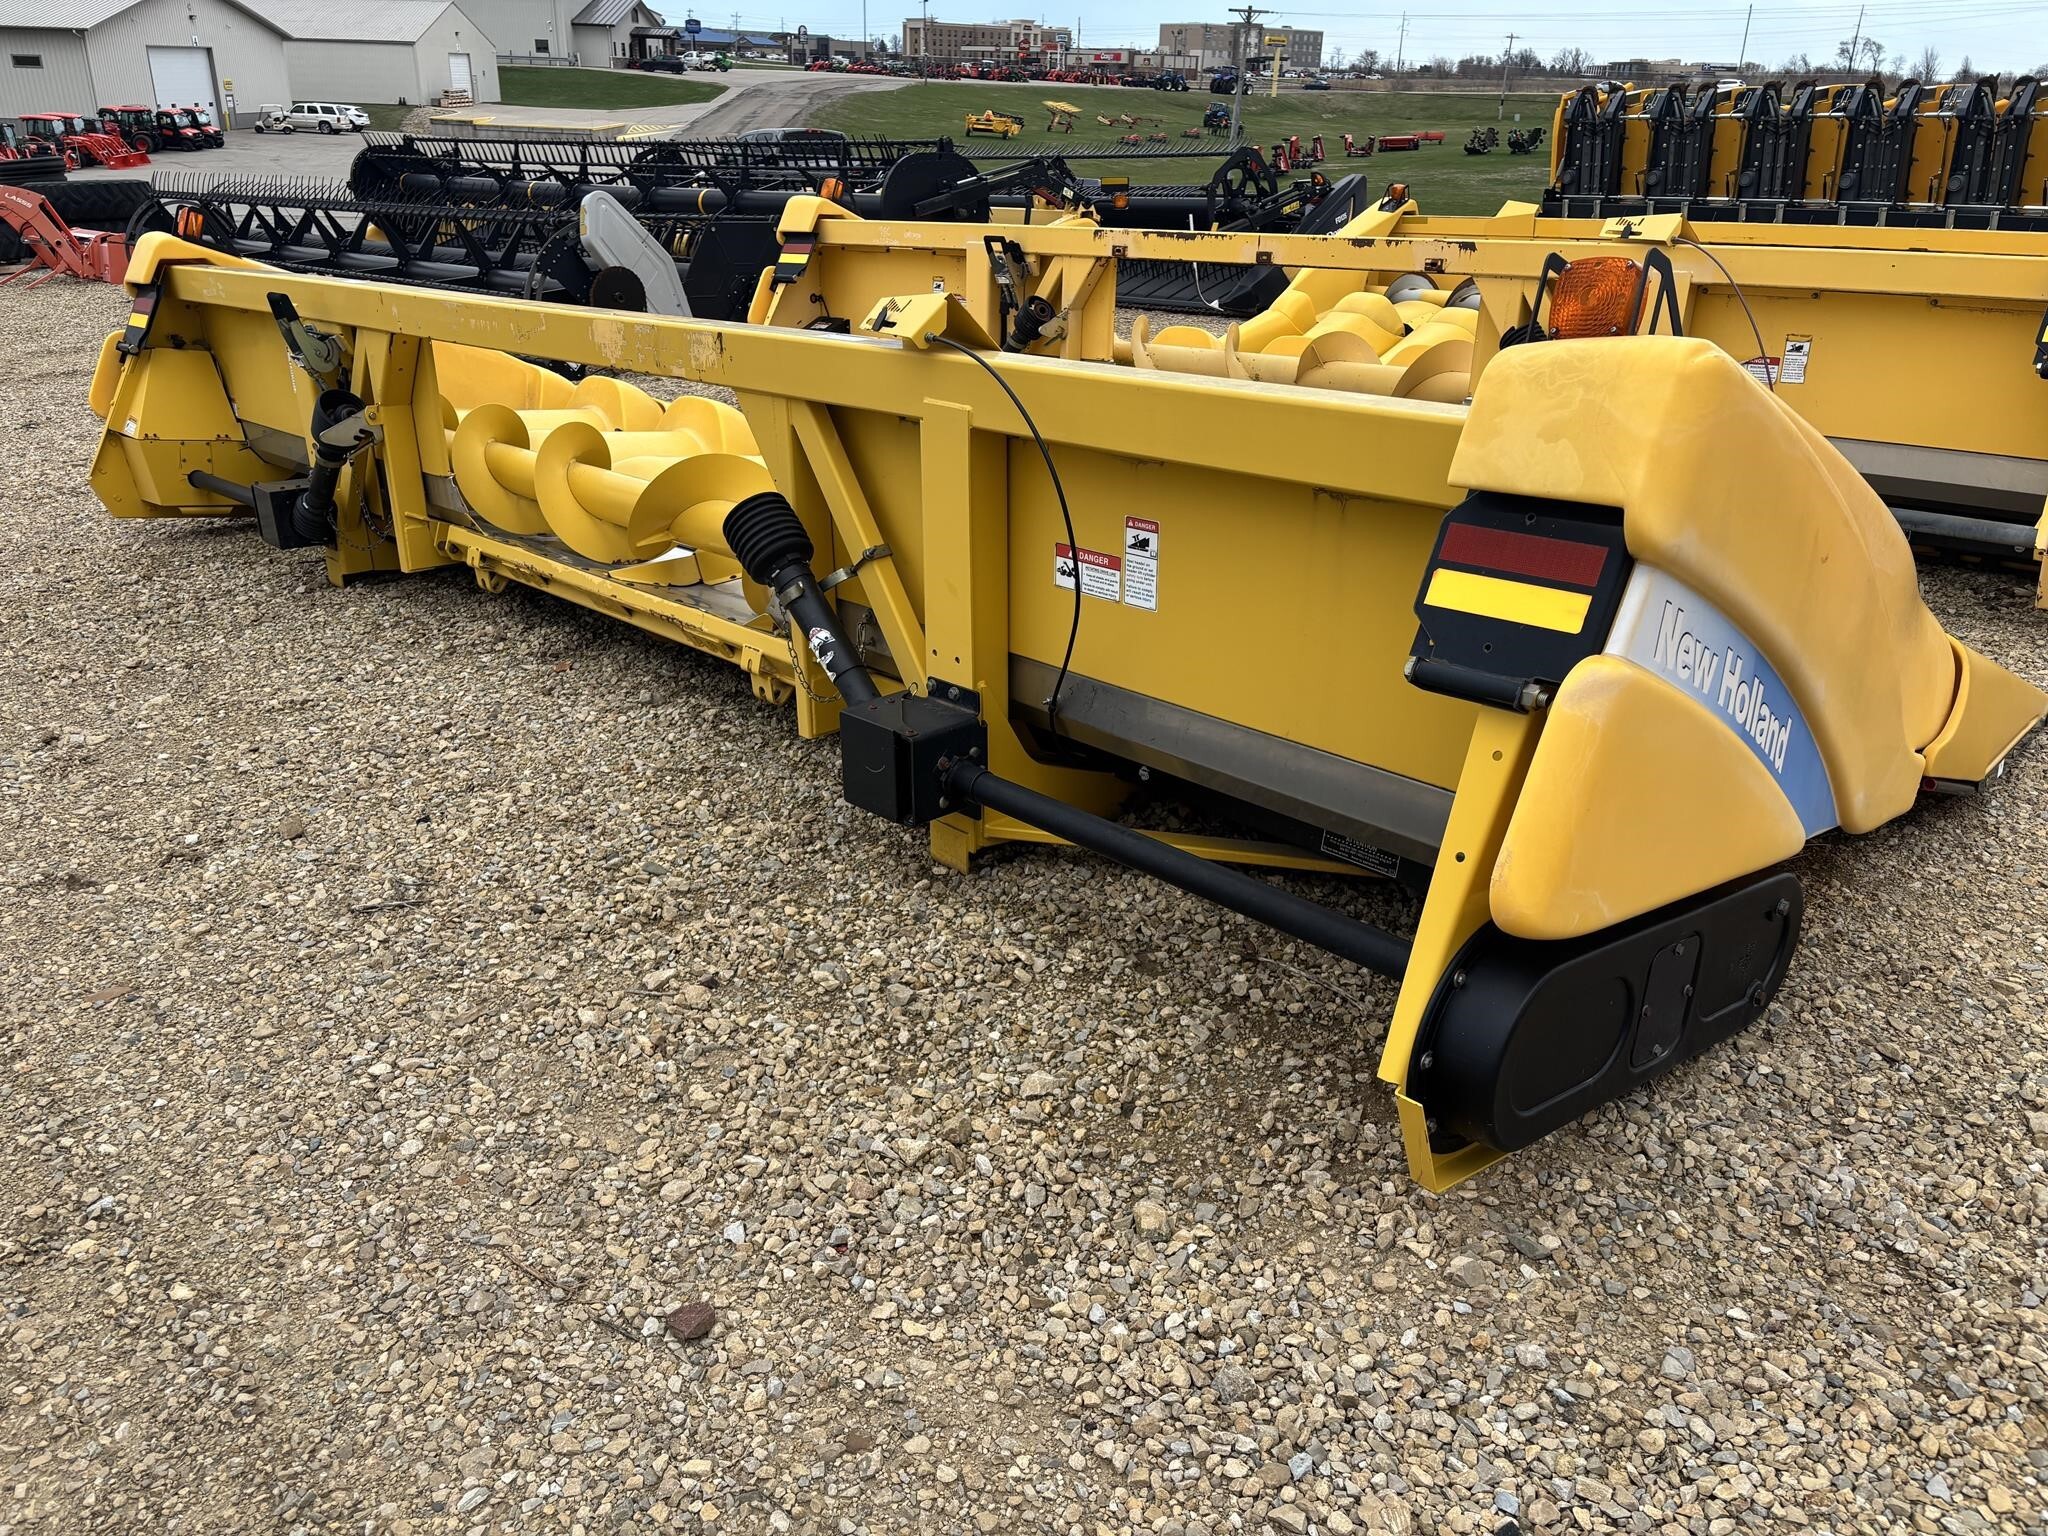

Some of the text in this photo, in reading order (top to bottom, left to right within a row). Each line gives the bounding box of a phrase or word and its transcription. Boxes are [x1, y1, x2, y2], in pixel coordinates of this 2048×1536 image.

[1134, 521, 1156, 530] DANGER
[1079, 552, 1109, 565] DANGER
[1654, 600, 1793, 774] New Holland
